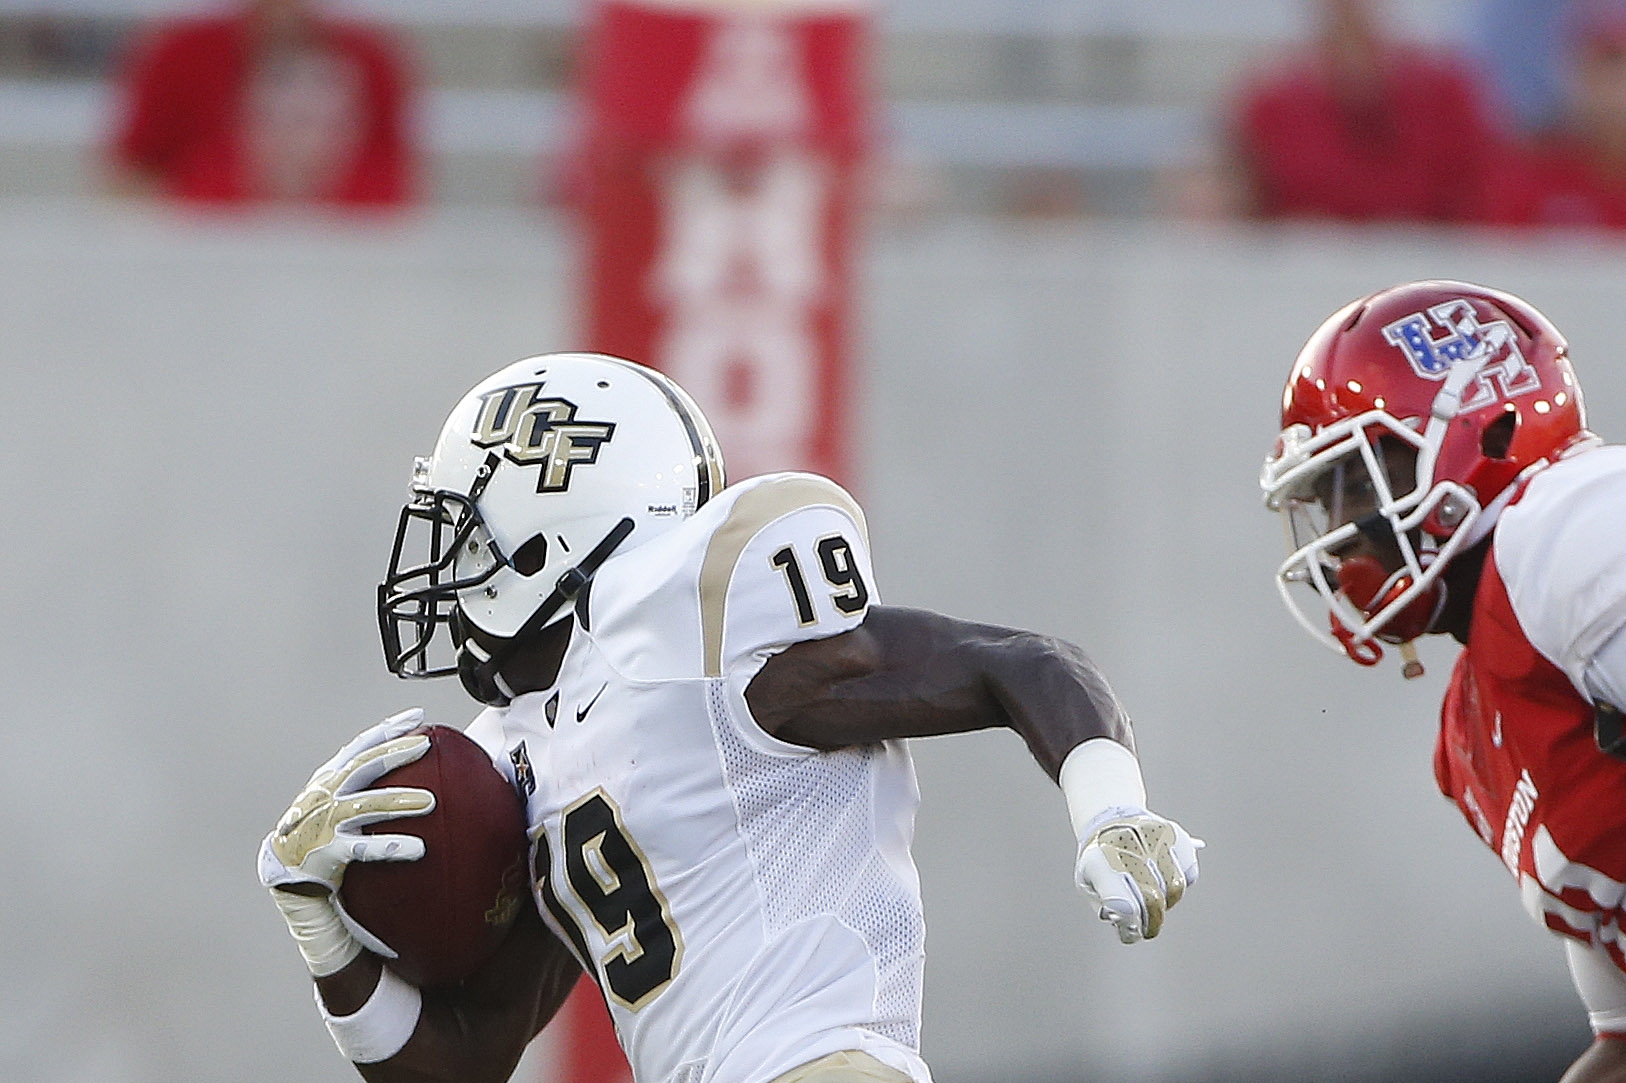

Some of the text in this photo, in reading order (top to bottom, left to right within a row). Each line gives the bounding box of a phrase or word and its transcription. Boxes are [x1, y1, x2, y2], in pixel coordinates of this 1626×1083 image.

[470, 381, 615, 493] UCF
[771, 532, 869, 627] 19
[527, 786, 685, 1013] 19
